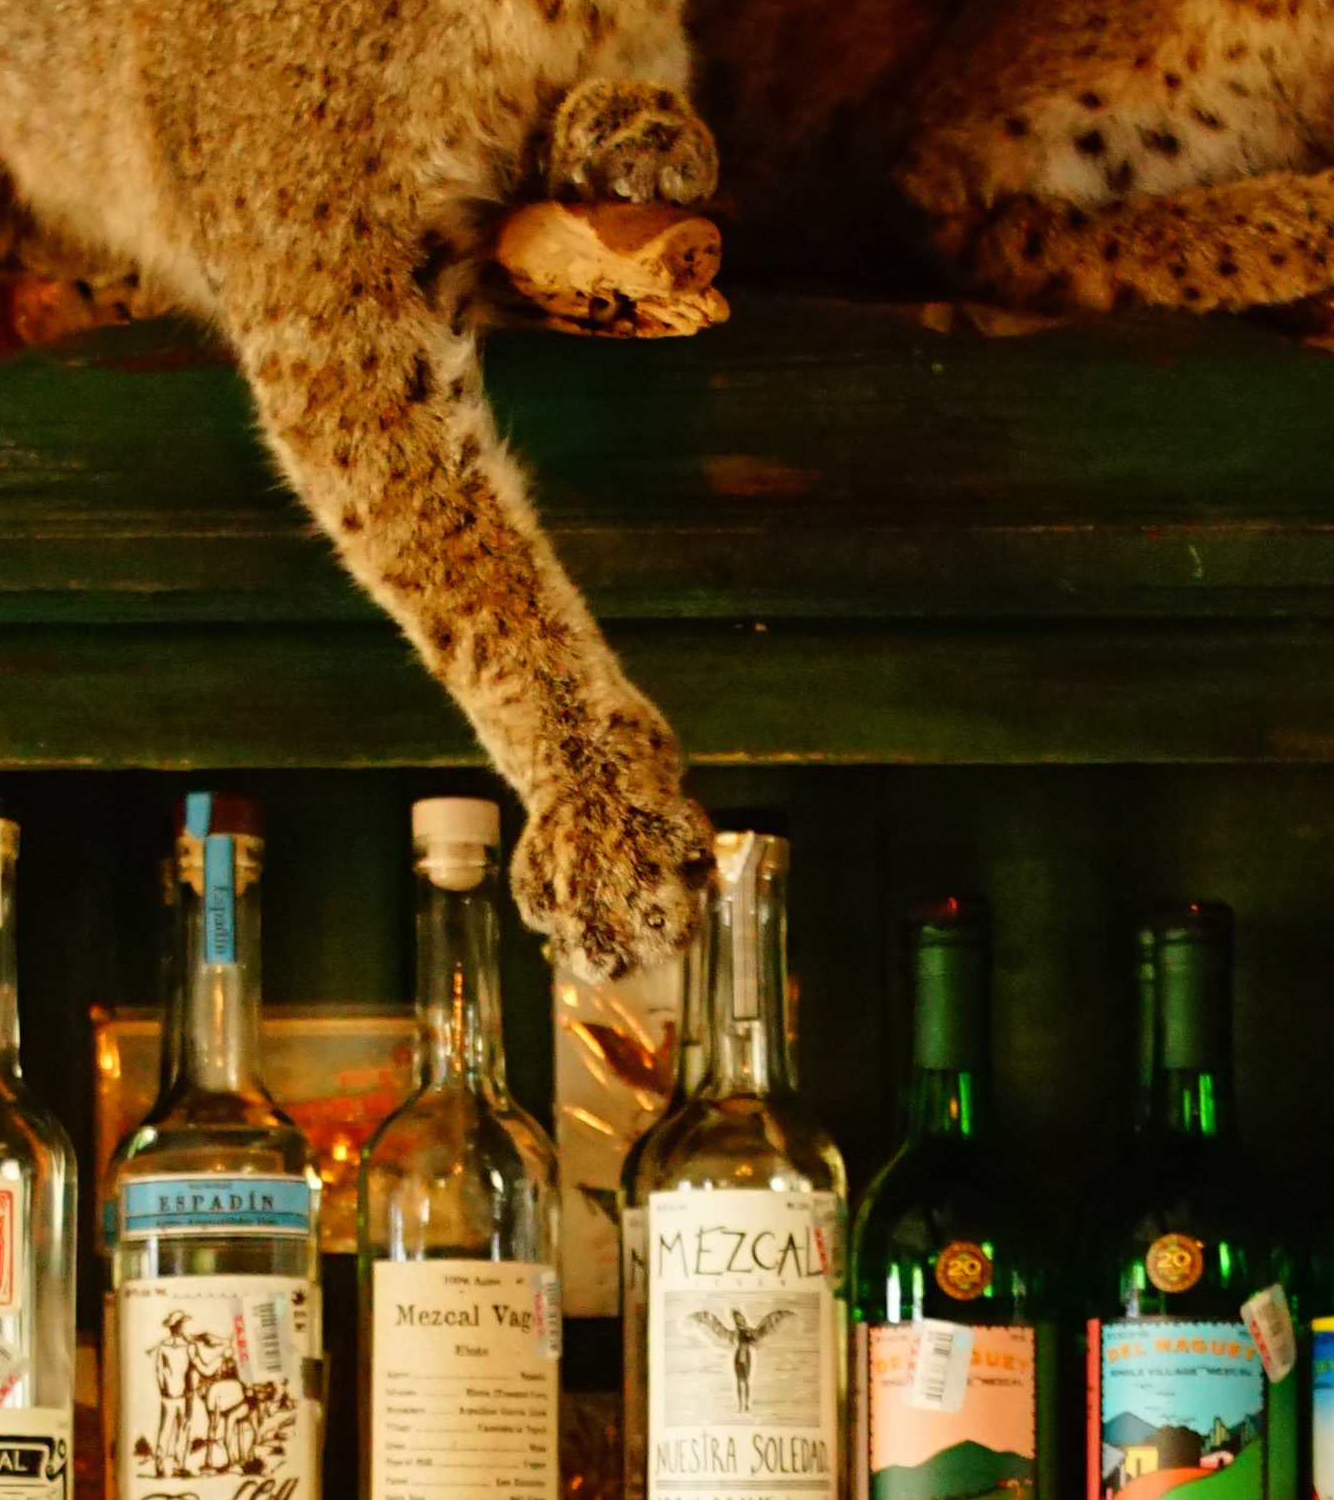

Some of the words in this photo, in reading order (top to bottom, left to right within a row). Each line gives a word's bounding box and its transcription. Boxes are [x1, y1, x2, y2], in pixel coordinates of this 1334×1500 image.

[159, 1191, 275, 1212] ESPADÍN
[658, 1226, 827, 1278] MEZCAL
[947, 1260, 982, 1276] 20
[395, 1304, 479, 1326] Mezcal
[491, 1304, 533, 1333] Vag
[1154, 1337, 1255, 1362] MAGUEY
[656, 1431, 737, 1474] NUESTRA
